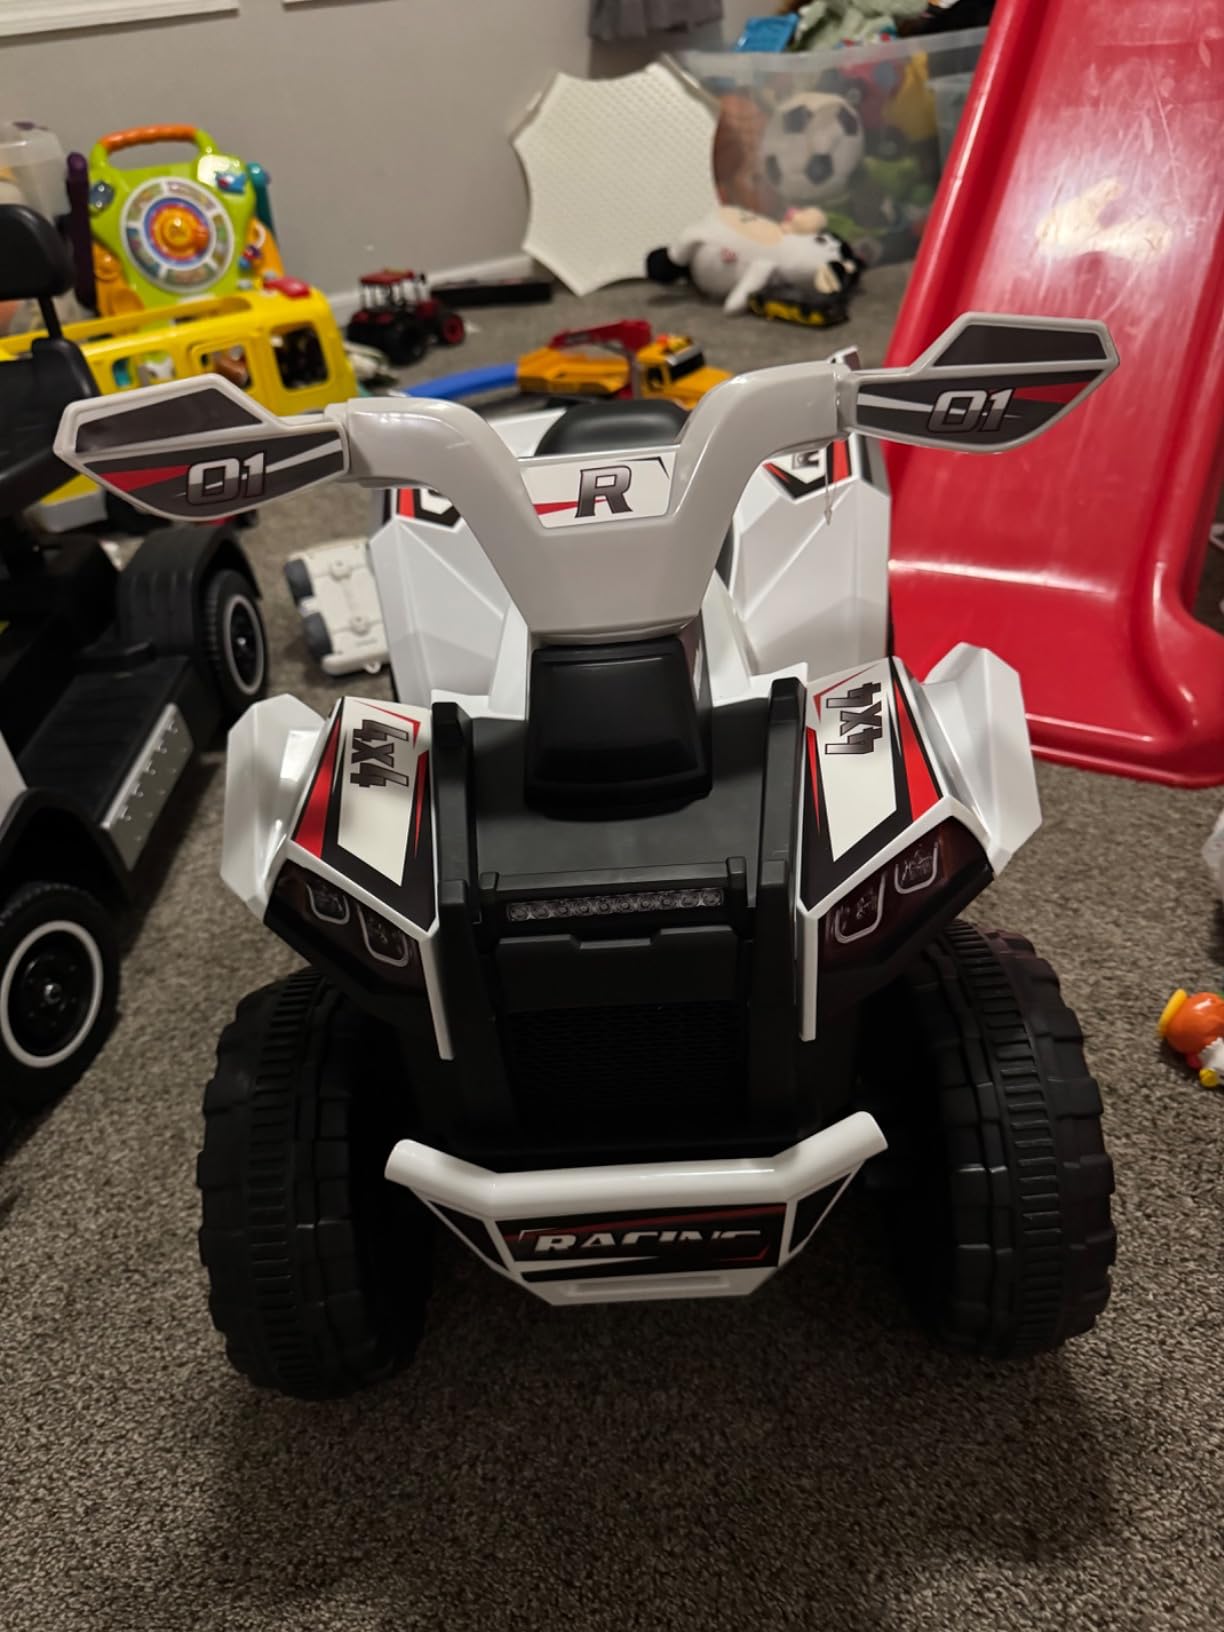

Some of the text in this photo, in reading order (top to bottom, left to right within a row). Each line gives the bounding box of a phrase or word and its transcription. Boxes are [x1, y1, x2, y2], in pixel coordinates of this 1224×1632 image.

[927, 388, 1015, 433] 01
[186, 450, 264, 505] 01
[575, 465, 633, 518] R
